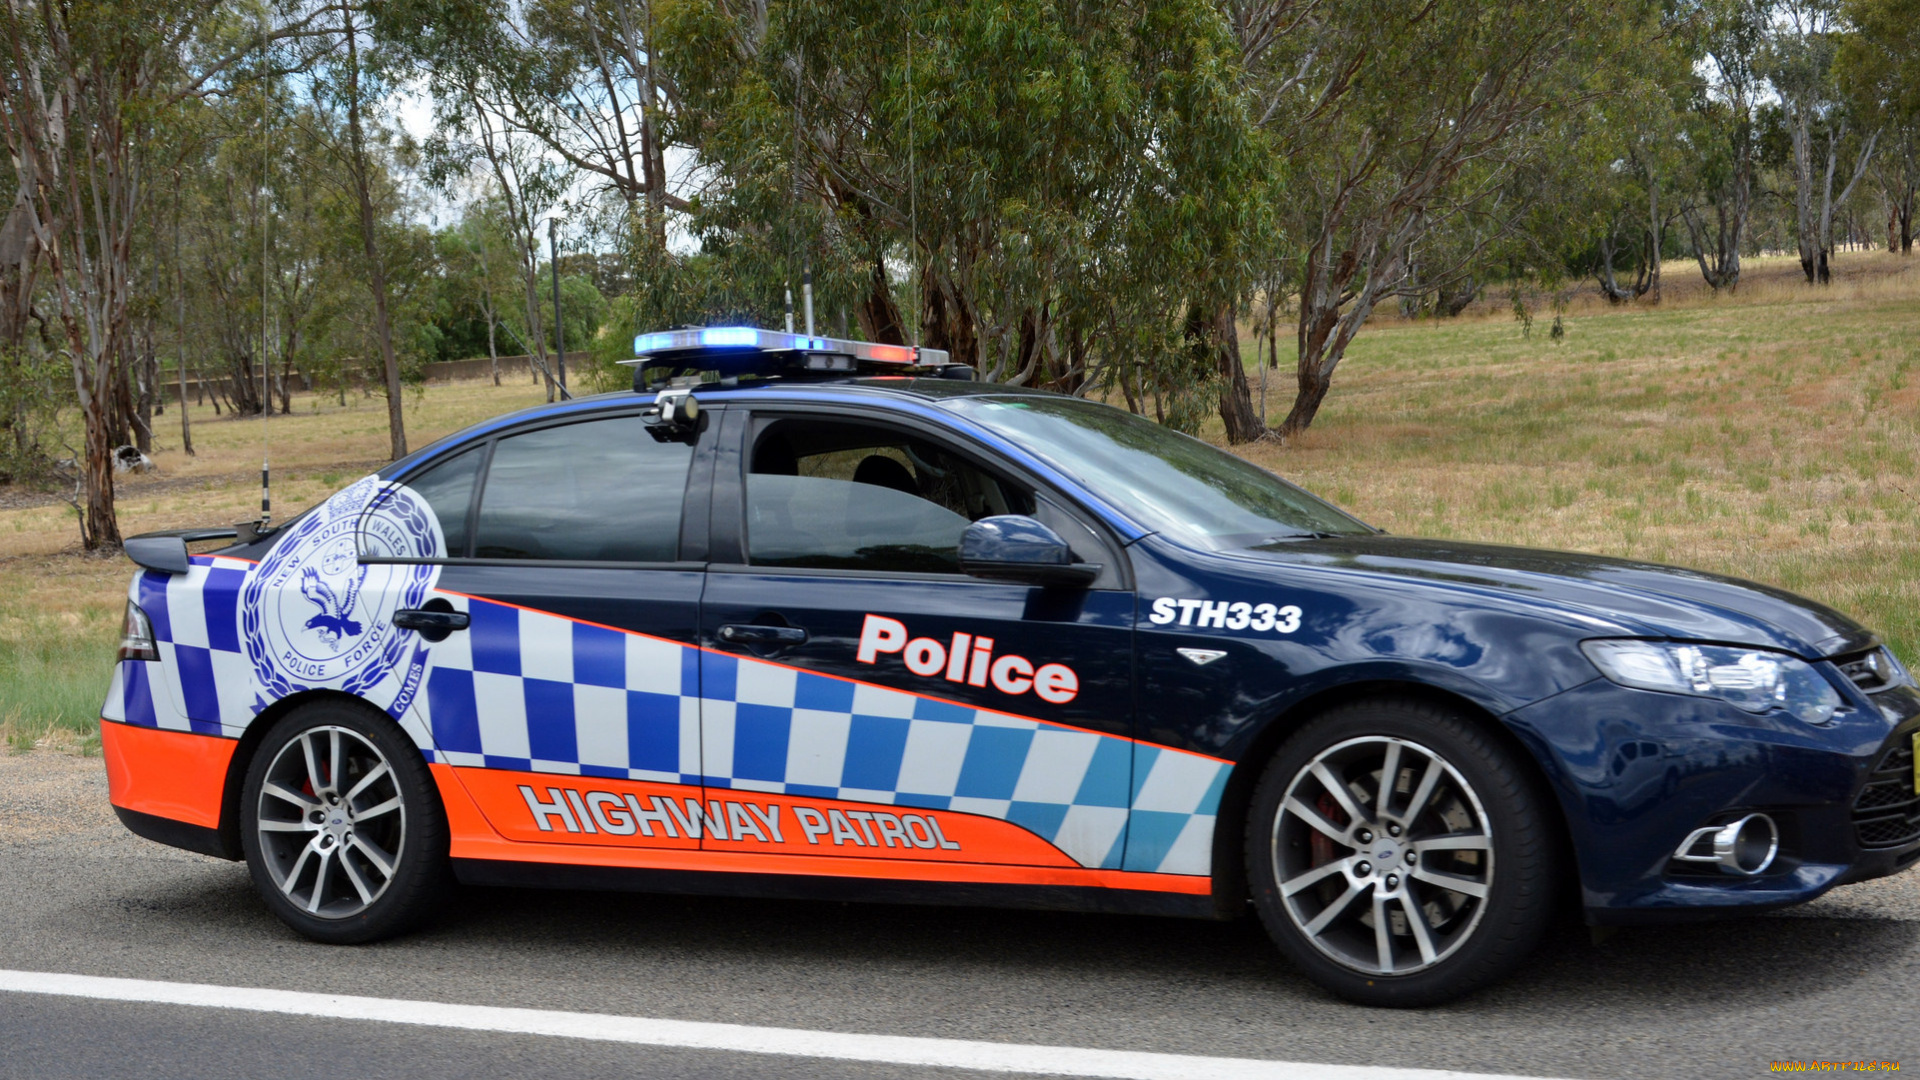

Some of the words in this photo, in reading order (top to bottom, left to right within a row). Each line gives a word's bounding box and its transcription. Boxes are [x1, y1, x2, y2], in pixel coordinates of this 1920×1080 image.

[273, 556, 301, 588] NEW
[312, 518, 359, 547] SOUTH
[372, 519, 406, 557] WALES
[1149, 597, 1301, 633] STH333
[282, 651, 326, 677] POLICE
[344, 619, 387, 668] FORCE
[856, 614, 1079, 704] Police
[393, 663, 423, 713] COMES
[517, 785, 785, 842] HIGHWAY
[792, 806, 961, 850] PATROL
